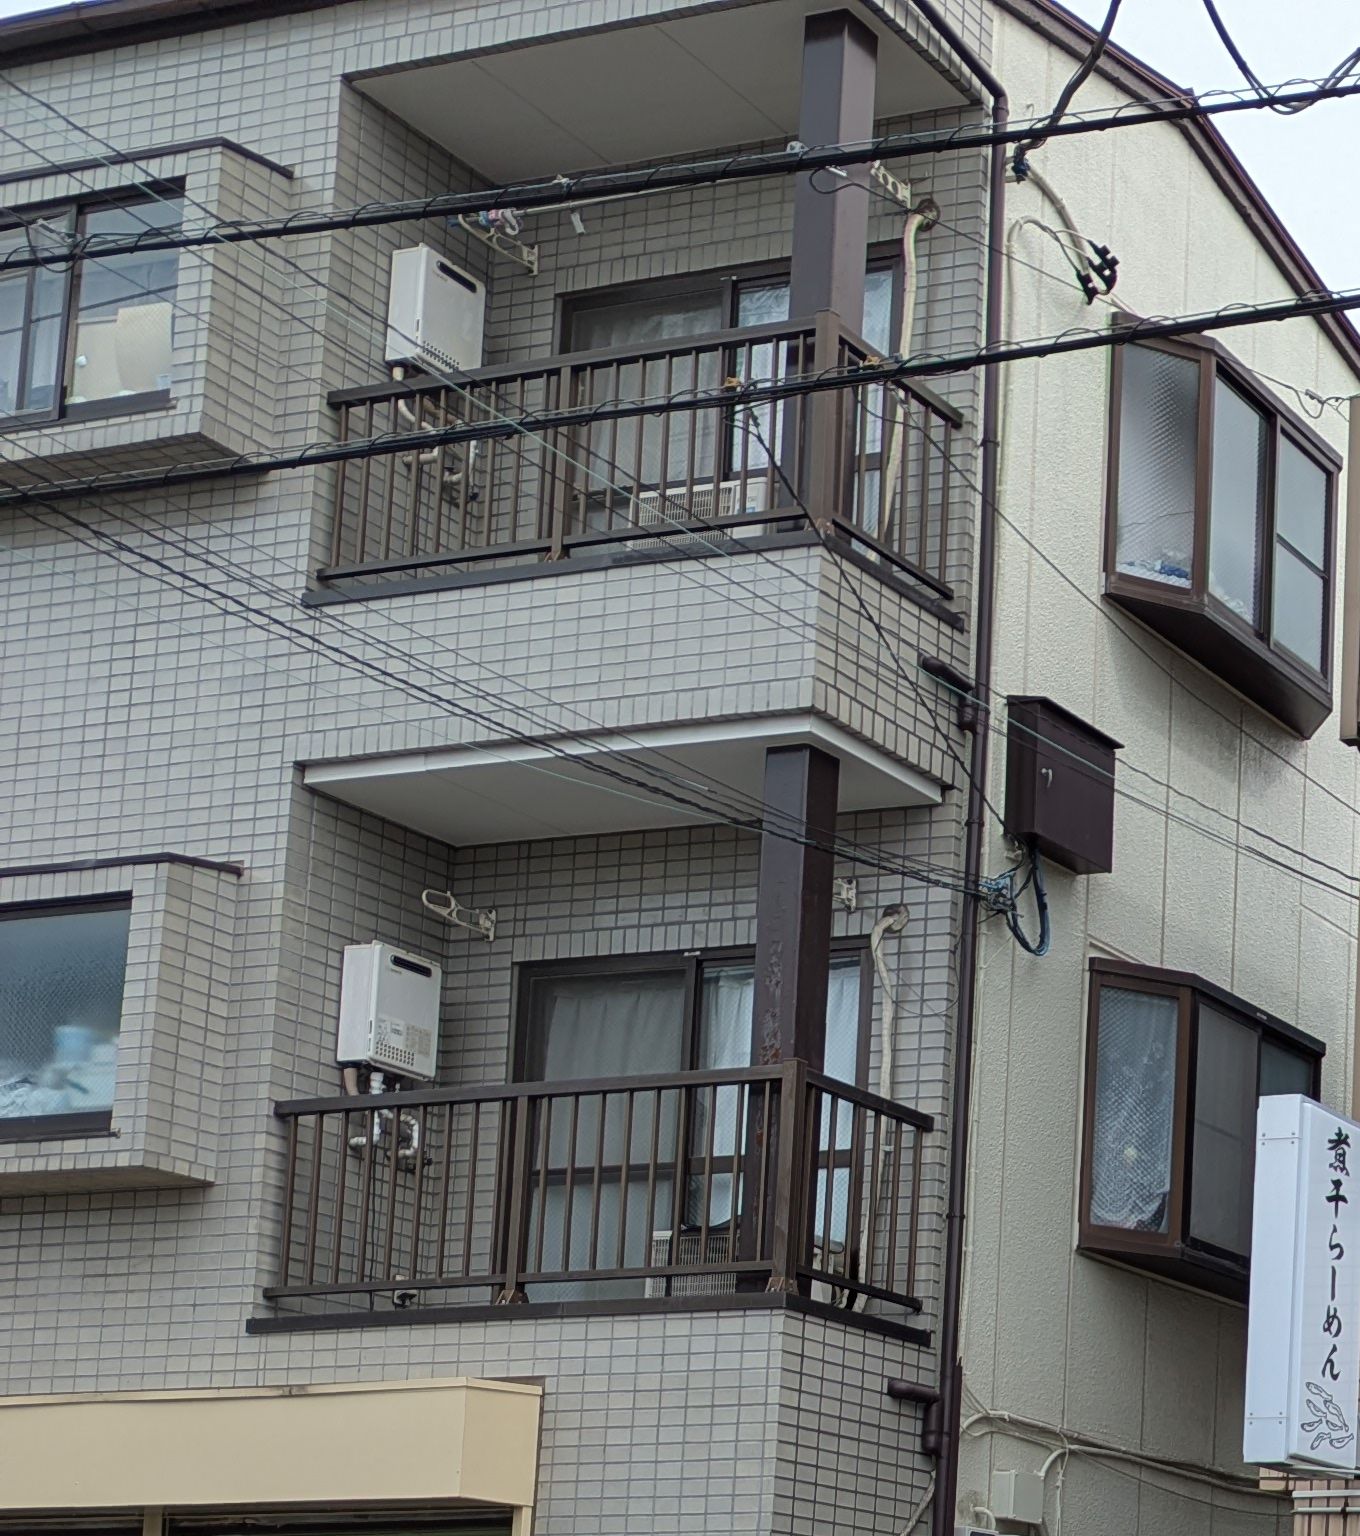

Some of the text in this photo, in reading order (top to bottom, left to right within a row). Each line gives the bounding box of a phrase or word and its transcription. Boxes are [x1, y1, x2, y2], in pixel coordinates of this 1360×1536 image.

[1321, 1127, 1352, 1382] 煮干らーめん
